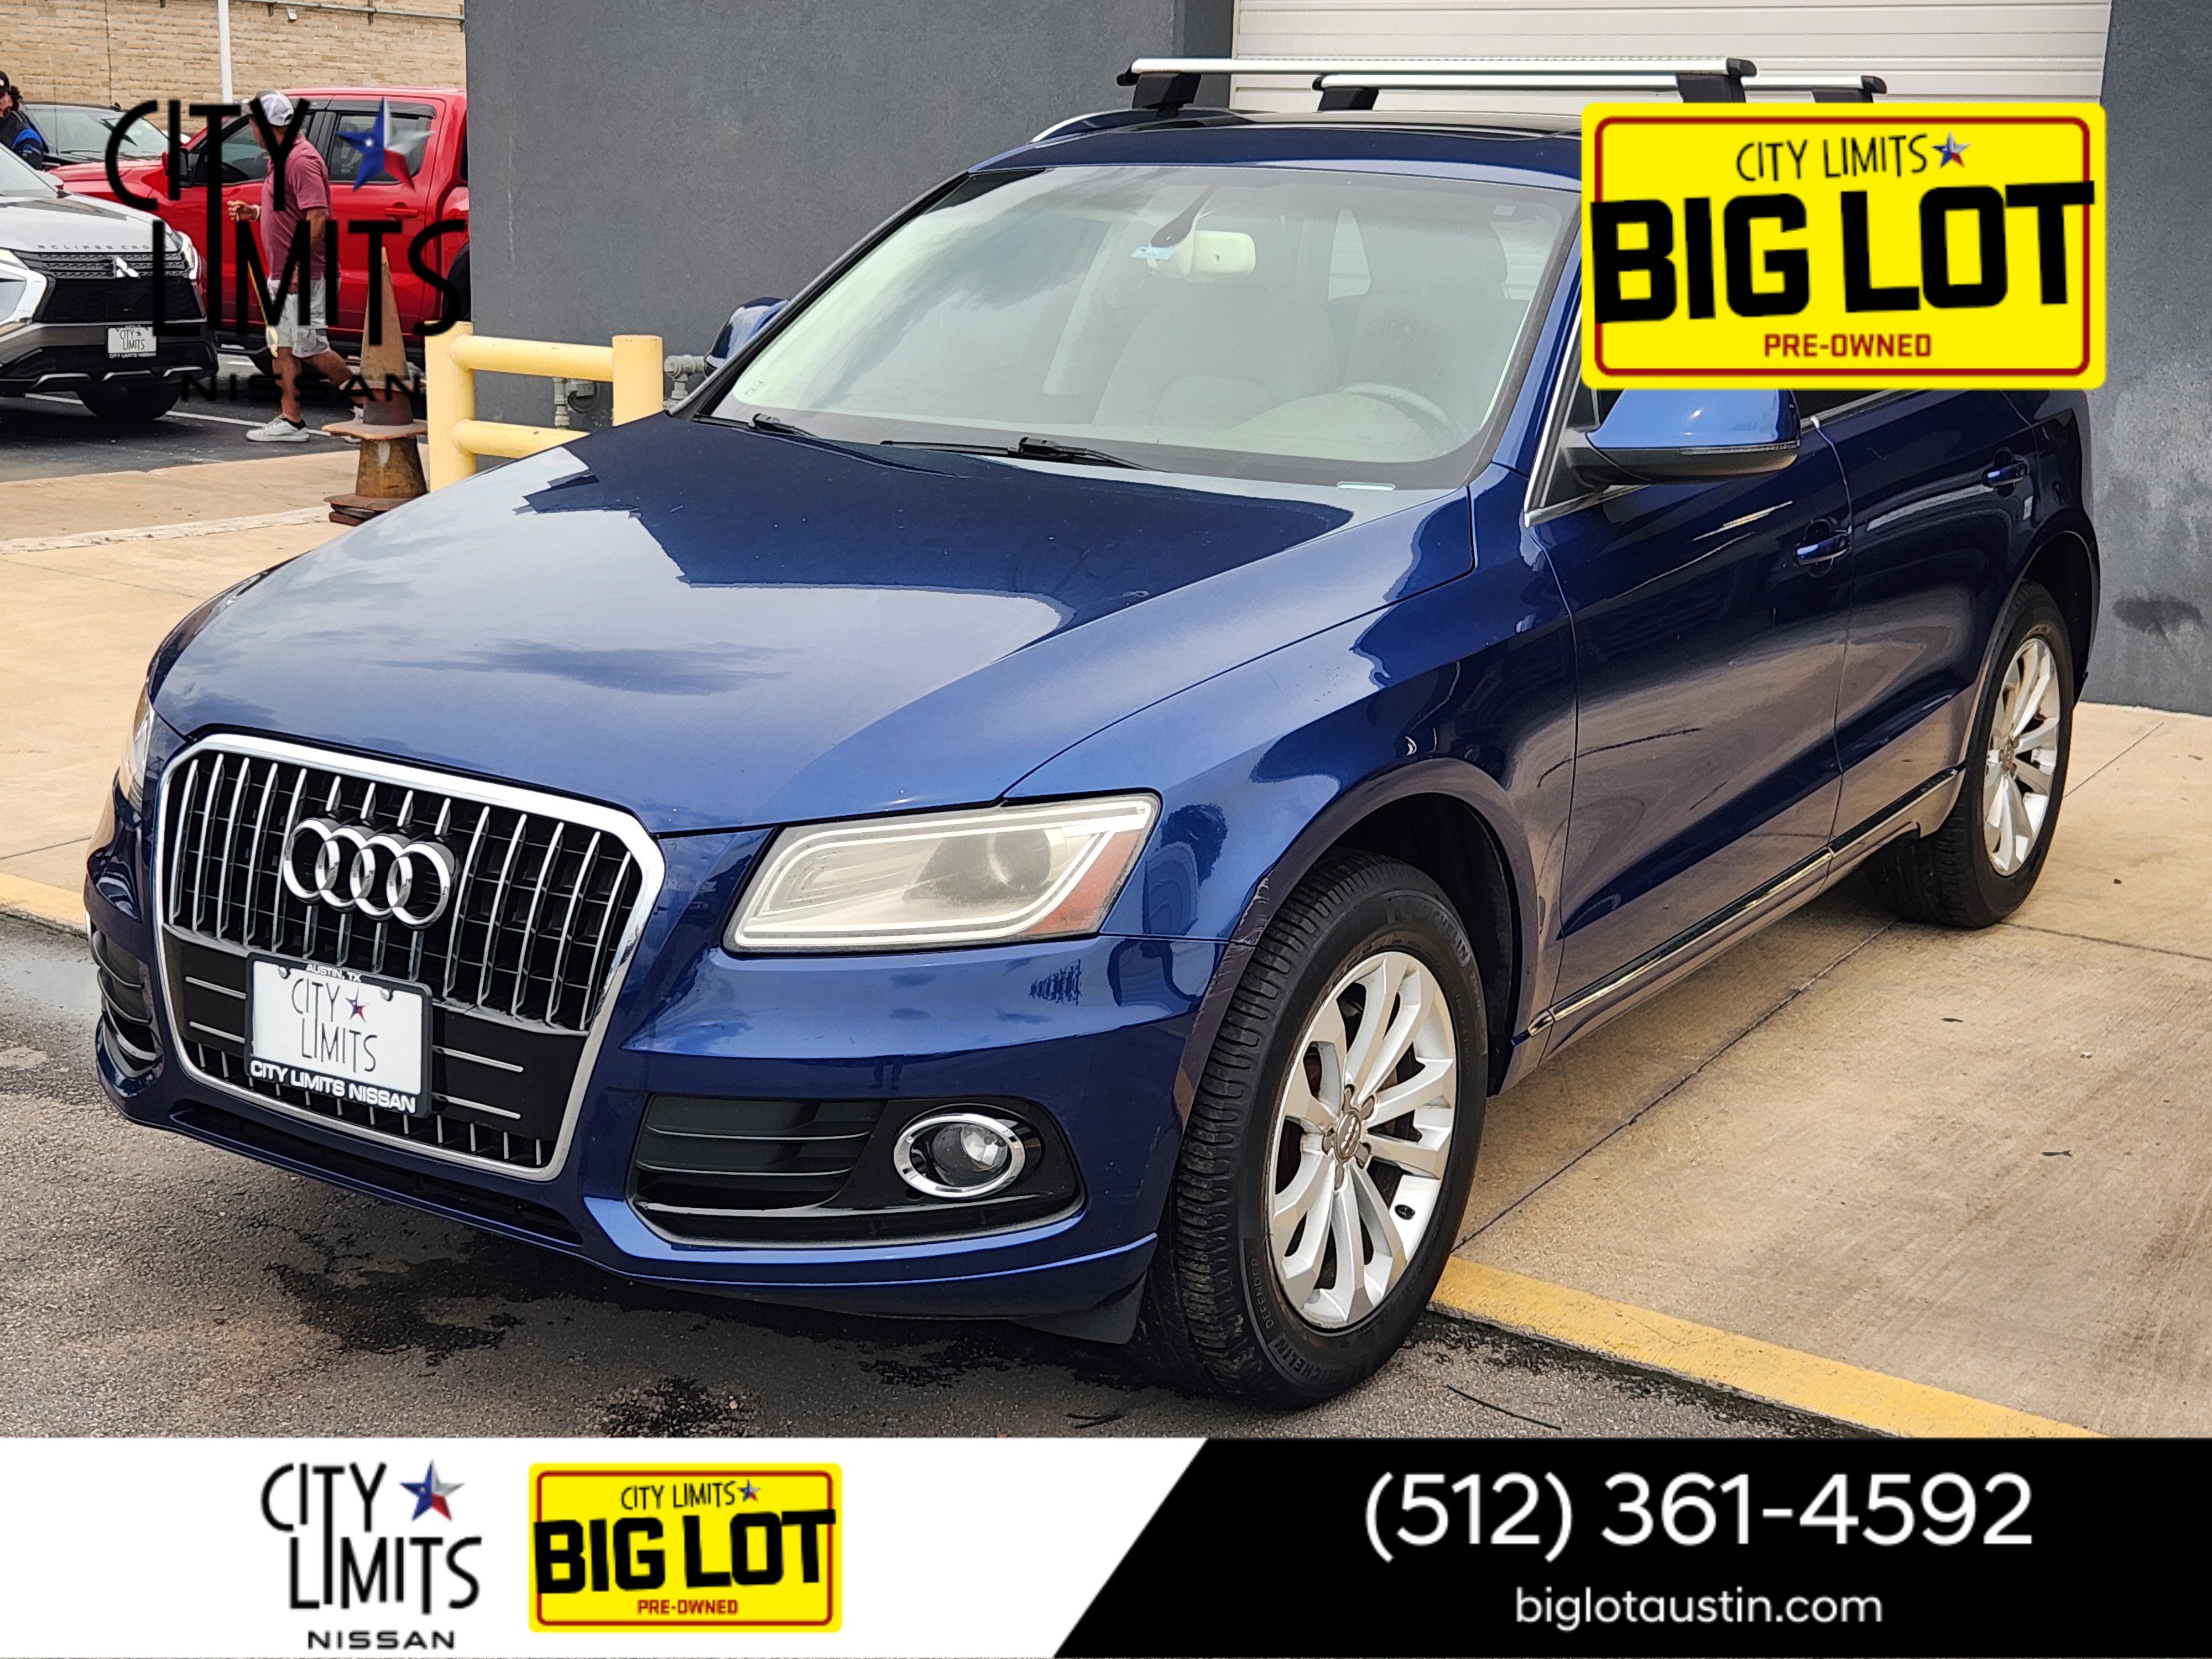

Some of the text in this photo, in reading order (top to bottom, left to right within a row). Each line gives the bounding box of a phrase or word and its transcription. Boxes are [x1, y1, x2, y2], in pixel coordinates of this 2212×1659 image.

[119, 329, 134, 340] CITY
[306, 963, 362, 983] AUSTIN, TX
[291, 978, 341, 1022] CITY
[301, 1018, 378, 1073] LIMITS
[250, 1060, 416, 1114] CITY LIMITS NISSAN
[1250, 1257, 1275, 1330] DEFENDER
